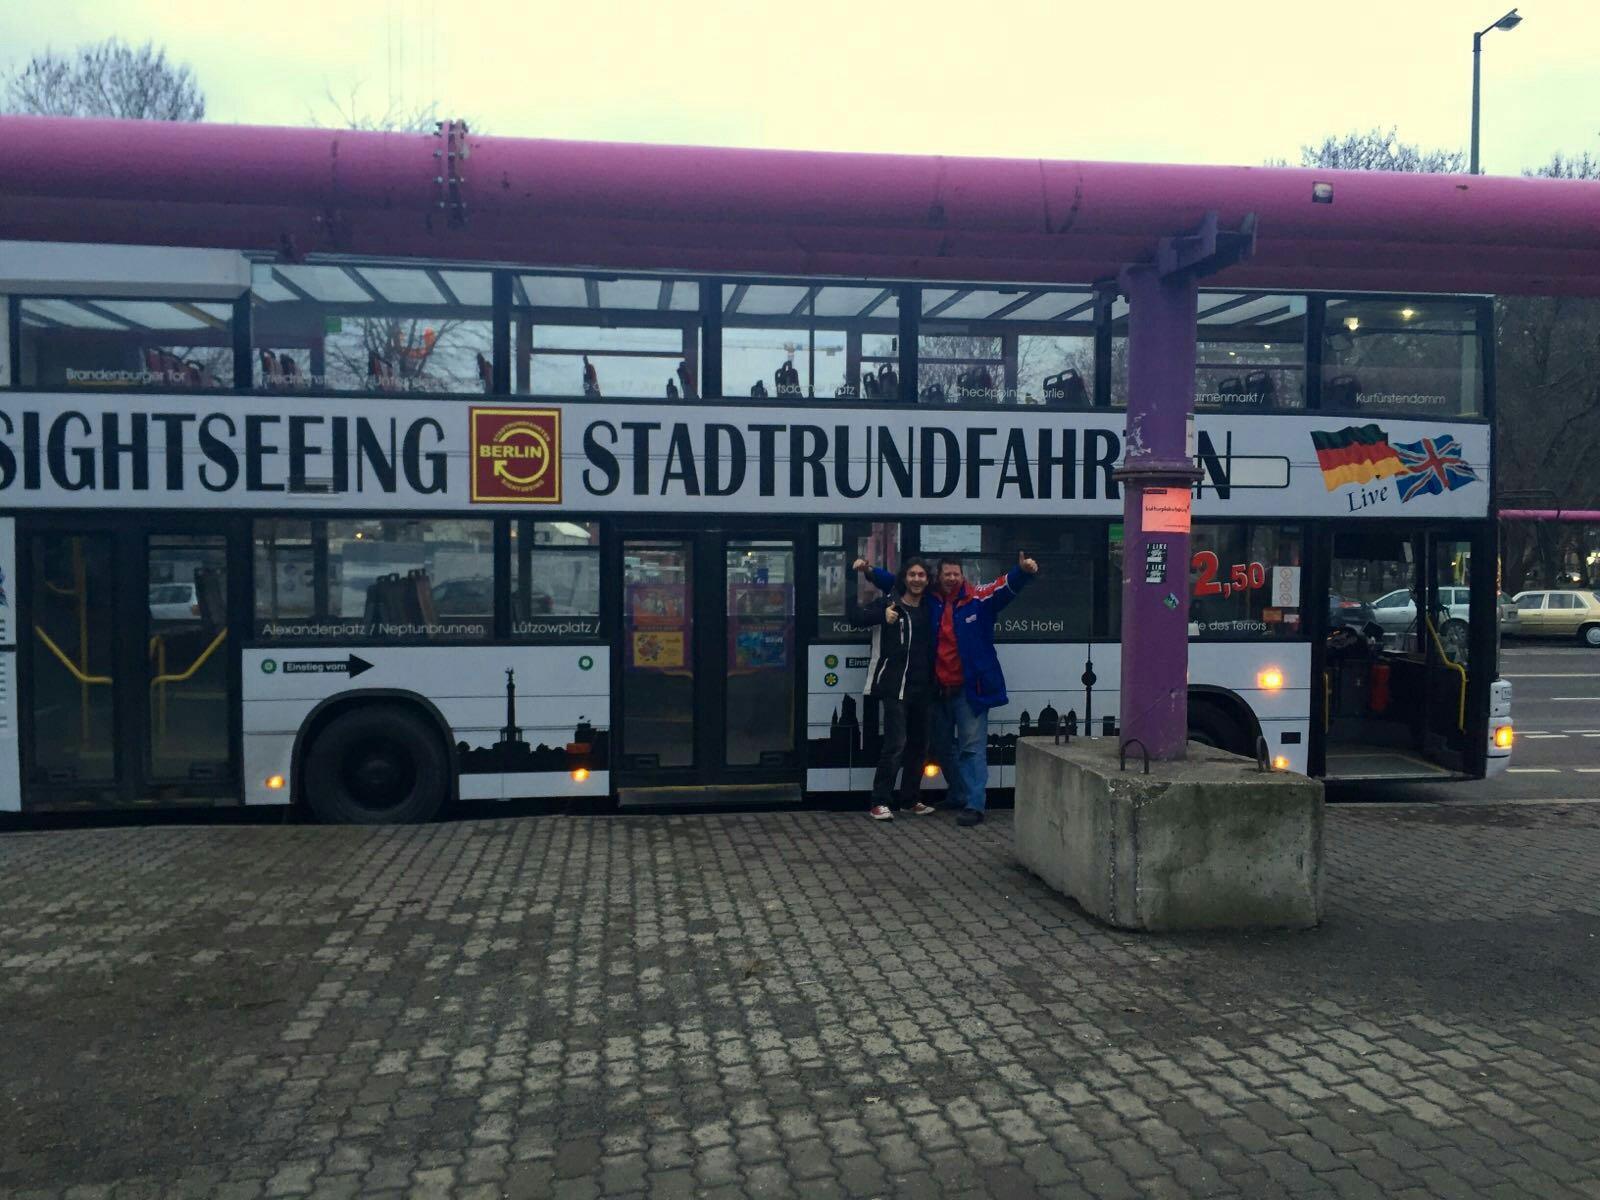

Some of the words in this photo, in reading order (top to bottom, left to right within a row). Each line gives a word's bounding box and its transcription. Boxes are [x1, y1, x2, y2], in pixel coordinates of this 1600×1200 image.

[65, 367, 164, 384] Brandenburger
[168, 370, 187, 382] Tor
[1356, 392, 1446, 404] Kurfürstendamm
[480, 444, 541, 458] BERLIN
[583, 420, 1231, 500] STADTRUNDFAHRN
[1346, 486, 1388, 512] Live
[1191, 550, 1266, 599] 2,50
[262, 624, 366, 636] Alexanderplatz
[379, 623, 484, 635] Neptunbrunnen
[1005, 620, 1028, 631] SAS
[1031, 619, 1064, 631] Hotel
[1209, 621, 1229, 631] des
[1233, 620, 1267, 631] Terrors
[287, 663, 323, 672] Einstieg
